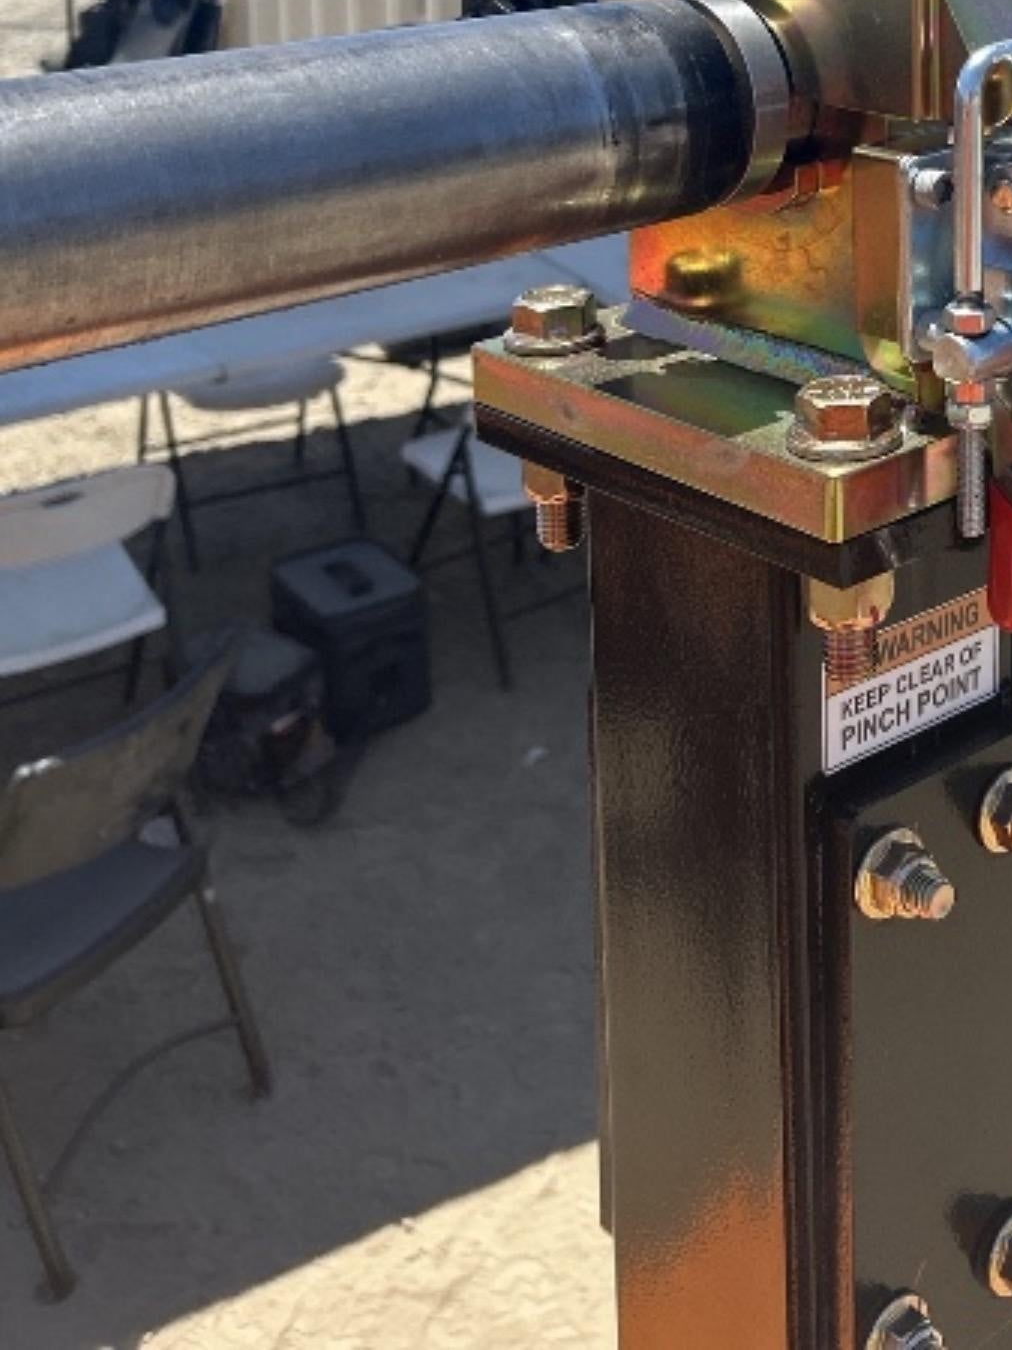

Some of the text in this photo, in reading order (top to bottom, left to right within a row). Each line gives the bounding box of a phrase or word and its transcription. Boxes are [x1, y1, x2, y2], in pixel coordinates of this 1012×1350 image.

[876, 602, 979, 666] WARNING
[841, 641, 982, 720] KEEP CLEAR OF
[841, 666, 981, 750] PINCH POINT
